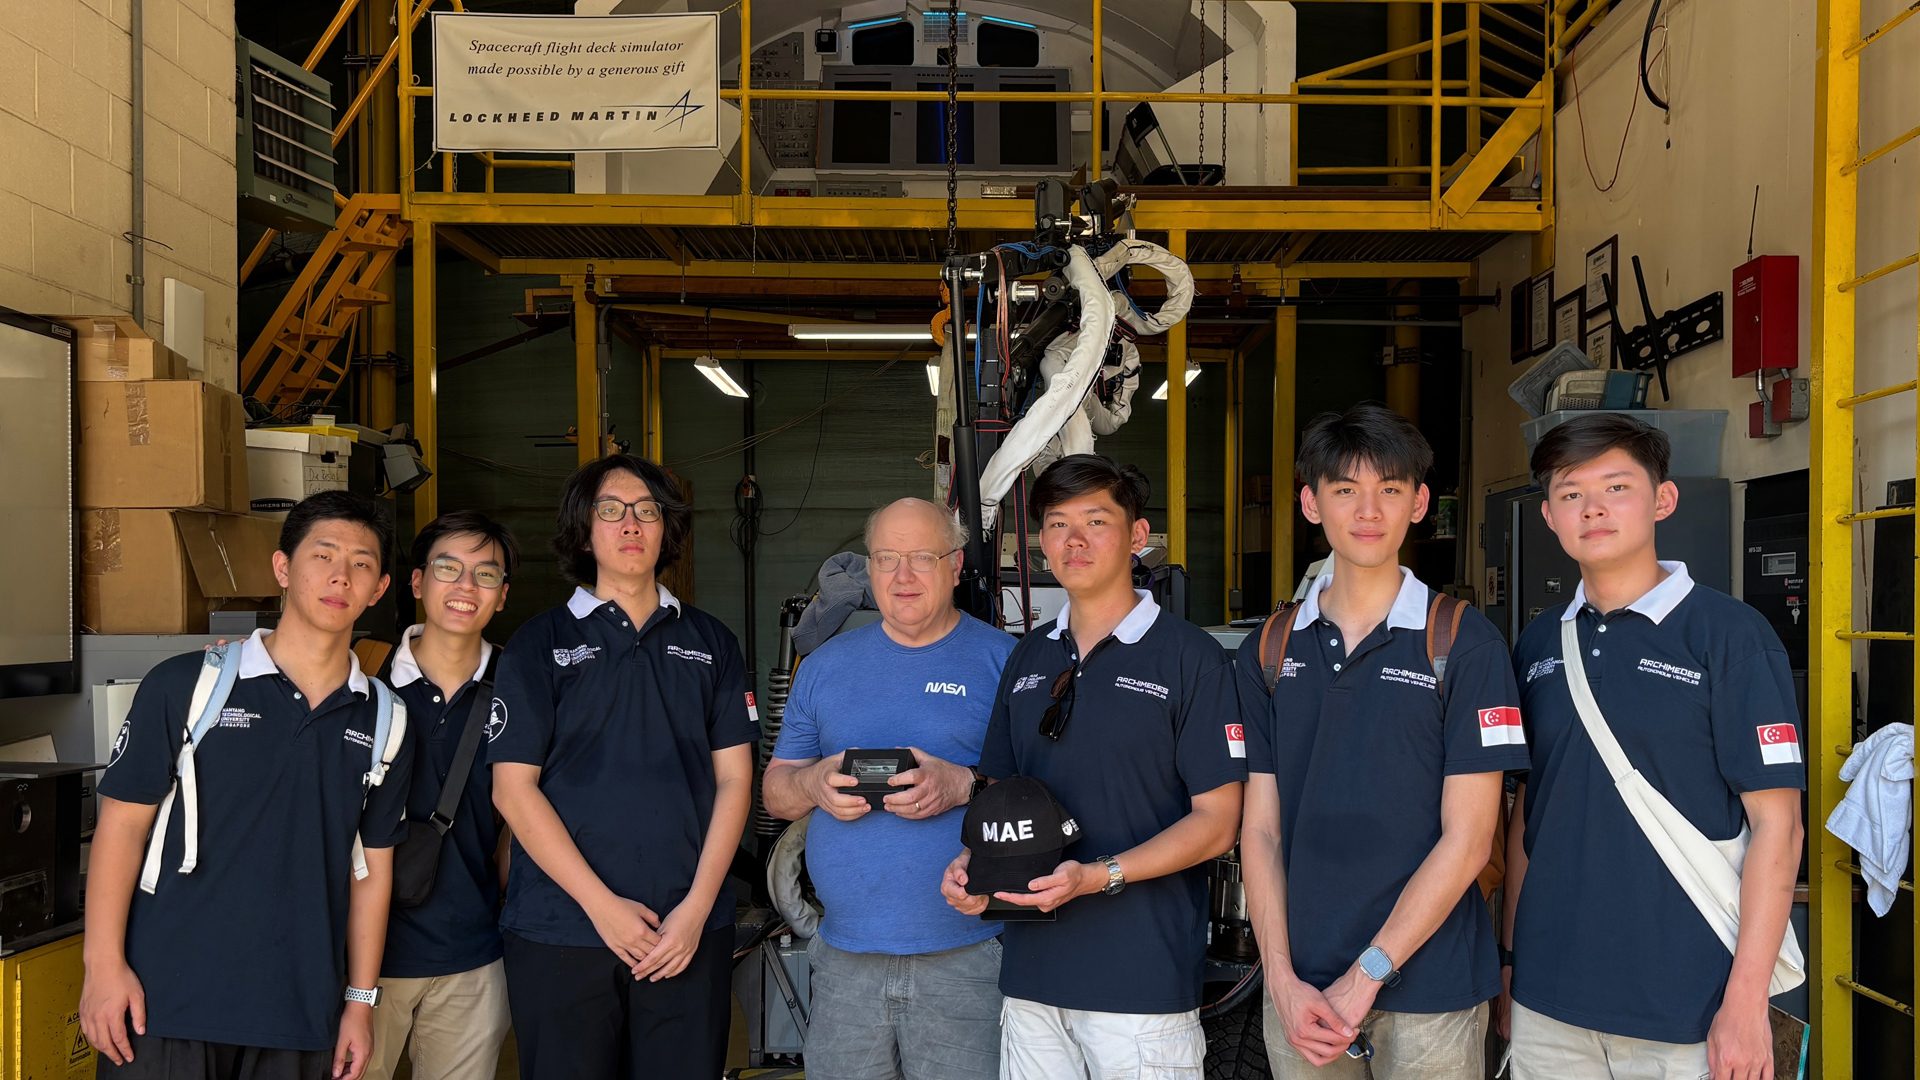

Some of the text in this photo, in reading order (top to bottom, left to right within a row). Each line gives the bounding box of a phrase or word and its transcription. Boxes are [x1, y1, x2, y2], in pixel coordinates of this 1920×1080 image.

[469, 39, 684, 56] Spacecraft flight deck simulator
[467, 60, 685, 79] made possible by a generous gift
[449, 110, 658, 123] LOCKHEED MARTIN
[1381, 667, 1437, 684] ARCHIMEDES
[1637, 665, 1700, 686] AUTONOMOUS VEHICLES
[1640, 658, 1702, 680] ARCHIMEDES
[924, 681, 967, 697] NASA
[1116, 676, 1169, 695] ARCHIMEDES
[1380, 675, 1436, 690] AUTONOMOUS VEHICLES
[982, 819, 1034, 843] MAE
